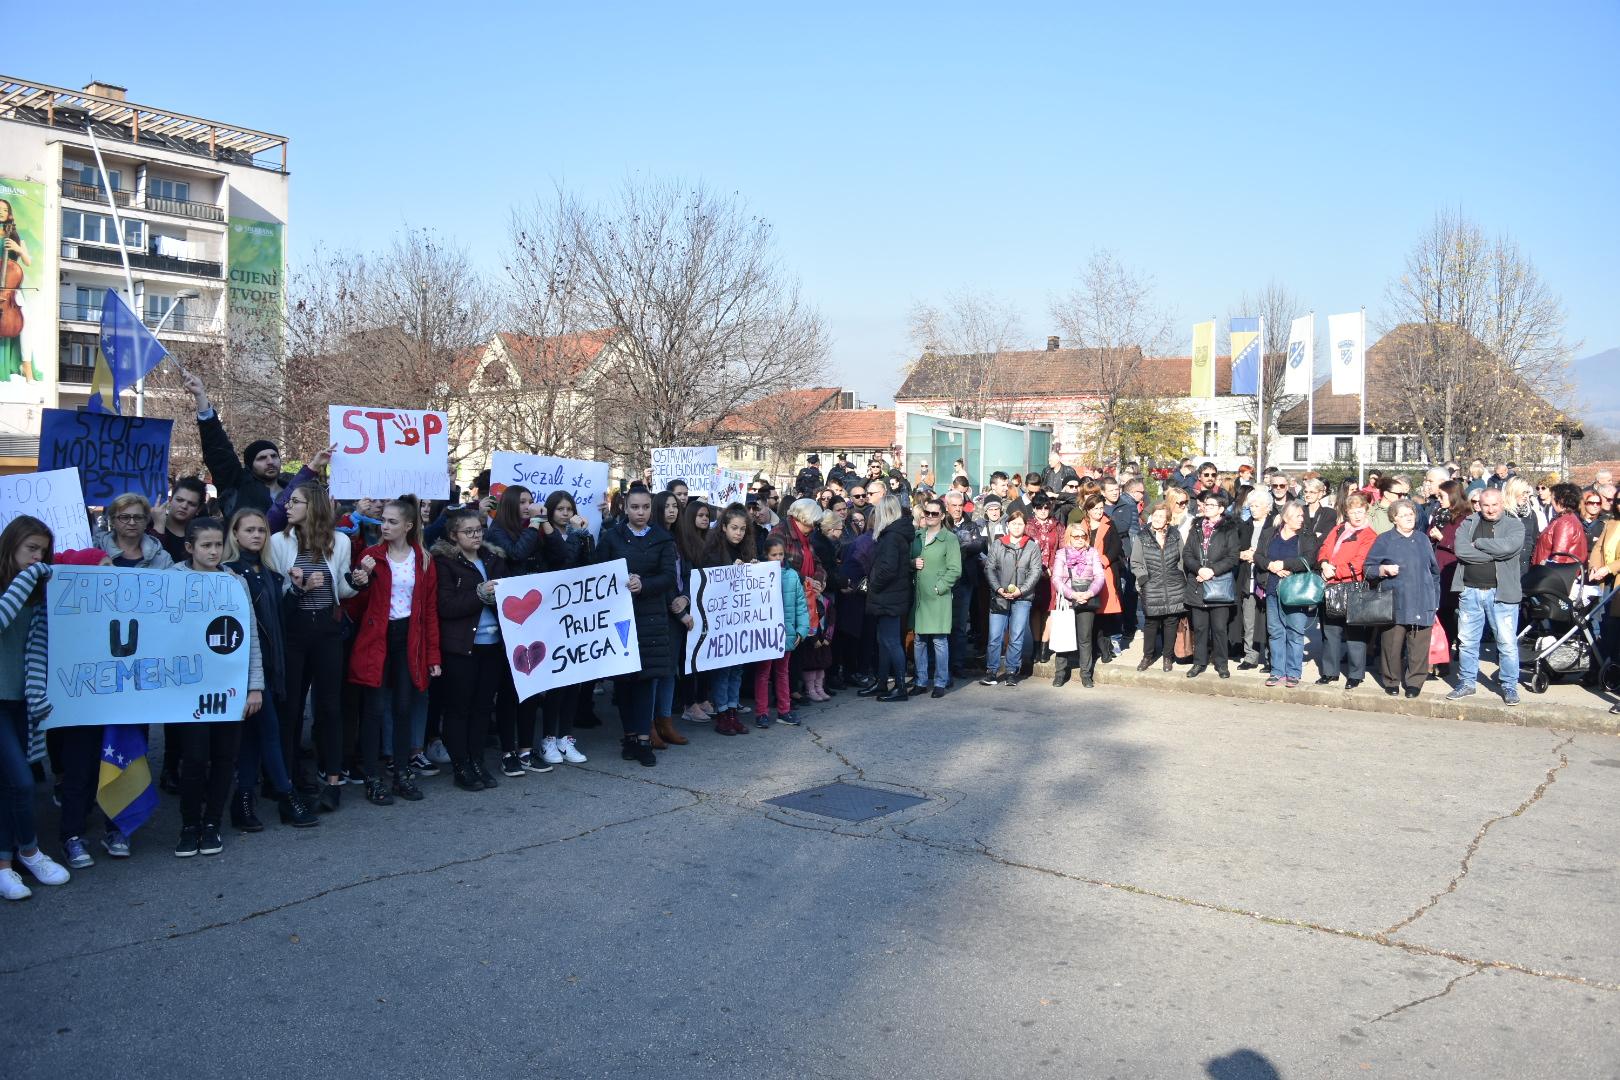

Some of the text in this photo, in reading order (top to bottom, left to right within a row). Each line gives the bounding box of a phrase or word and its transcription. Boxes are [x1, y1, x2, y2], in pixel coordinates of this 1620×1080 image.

[230, 268, 277, 286] CIJENI
[75, 412, 146, 443] STOP
[341, 409, 443, 455] STOP
[512, 462, 592, 489] Svezali ste
[551, 572, 619, 611] DJECA
[706, 589, 771, 613] GDJE STE VI
[558, 609, 611, 639] PRIJE
[714, 606, 773, 631] STUDIRALI
[109, 618, 139, 658] U
[706, 622, 786, 659] MEDICINU?
[56, 653, 203, 698] VREMENU
